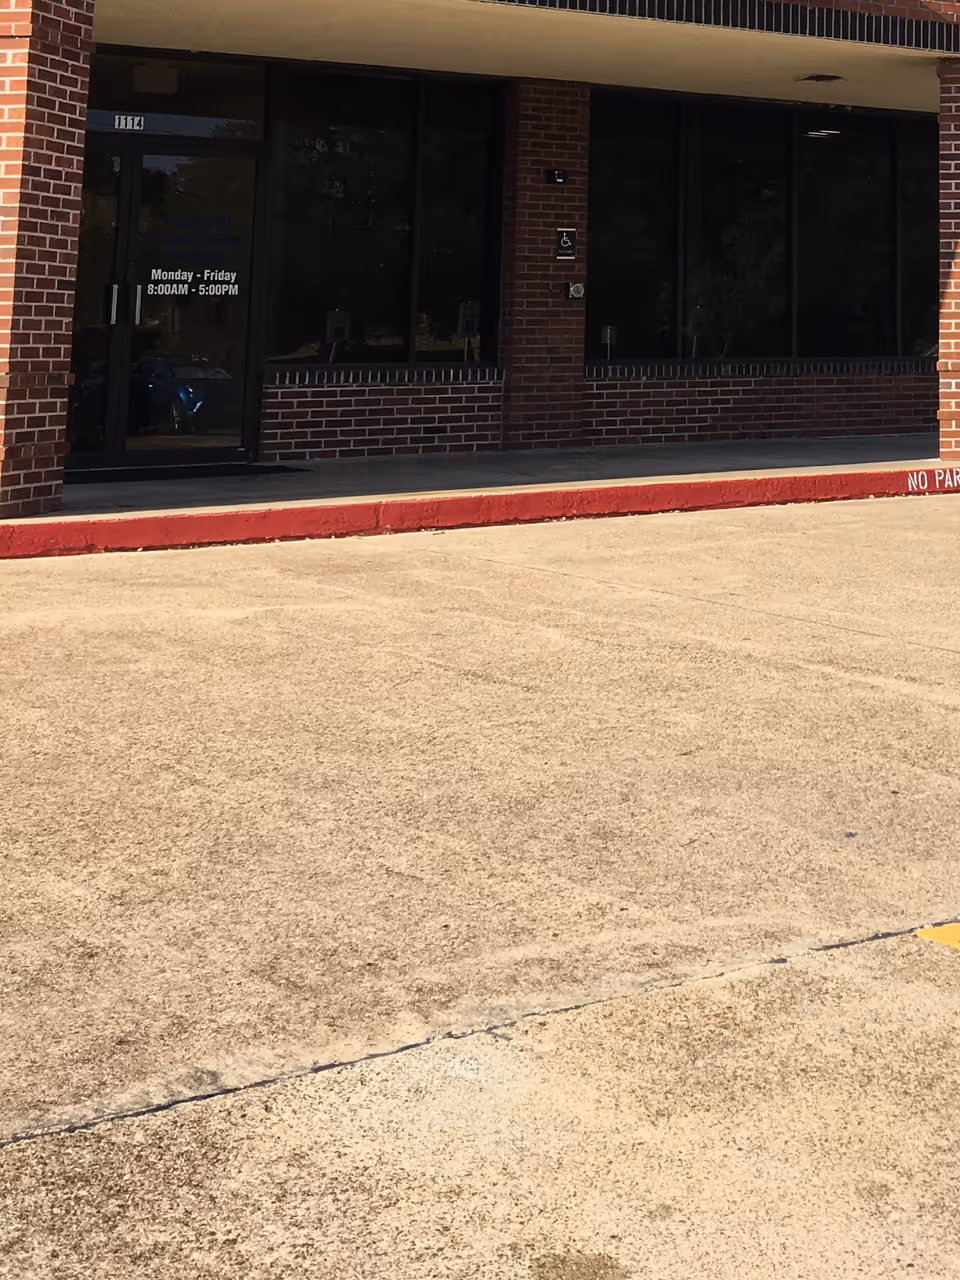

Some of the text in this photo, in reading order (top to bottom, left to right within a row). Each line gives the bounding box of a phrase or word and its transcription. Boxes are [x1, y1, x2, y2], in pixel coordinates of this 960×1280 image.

[115, 116, 143, 129] 1114
[151, 269, 193, 282] Monday
[204, 269, 236, 282] Friday
[147, 284, 188, 295] 8:00AM
[199, 284, 239, 295] 5:00PM
[908, 471, 928, 491] NO
